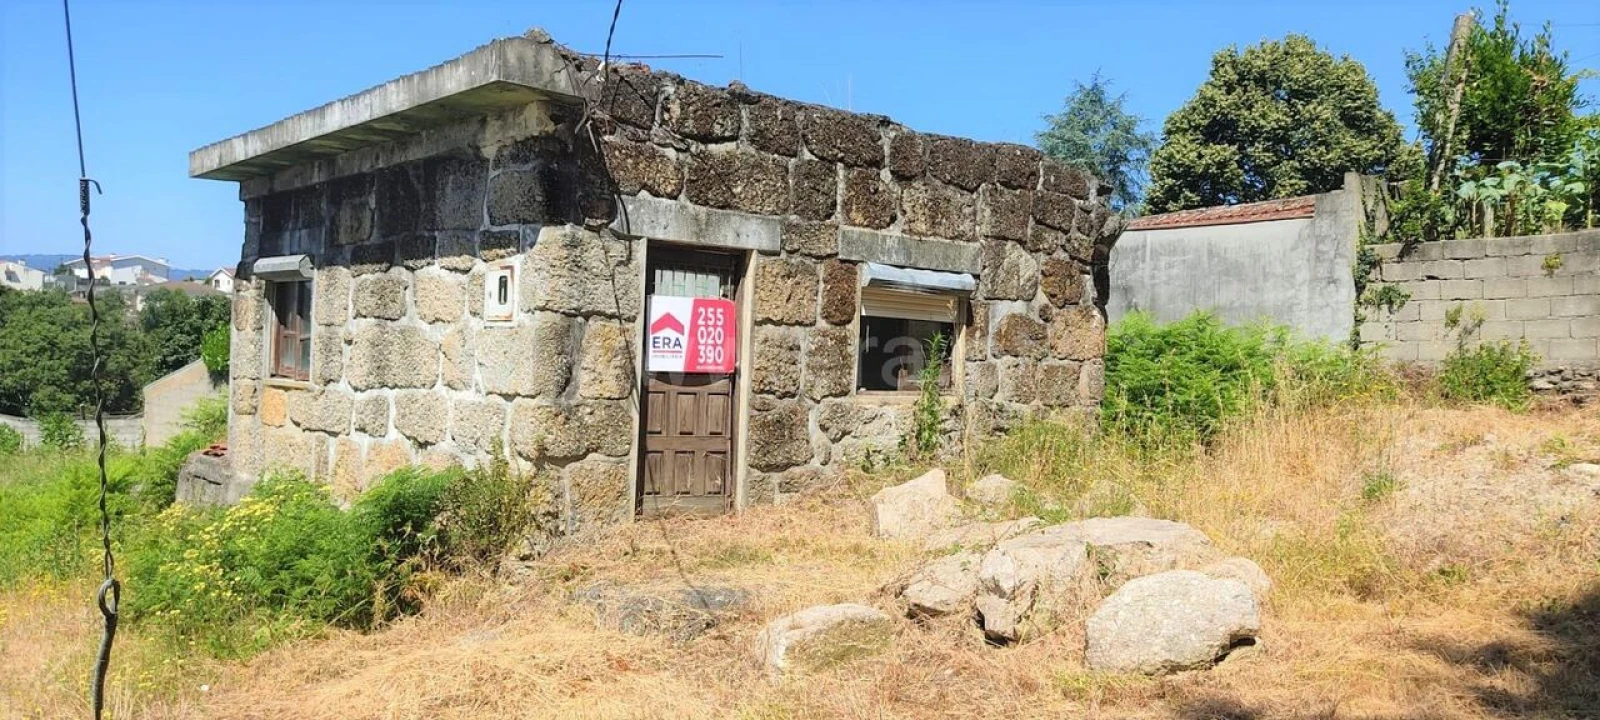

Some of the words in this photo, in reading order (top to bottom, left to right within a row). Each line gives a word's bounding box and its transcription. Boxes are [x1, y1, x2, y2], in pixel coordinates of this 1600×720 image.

[697, 307, 724, 325] 255
[652, 336, 683, 349] ERA
[697, 326, 724, 345] 020
[697, 345, 724, 364] 390
